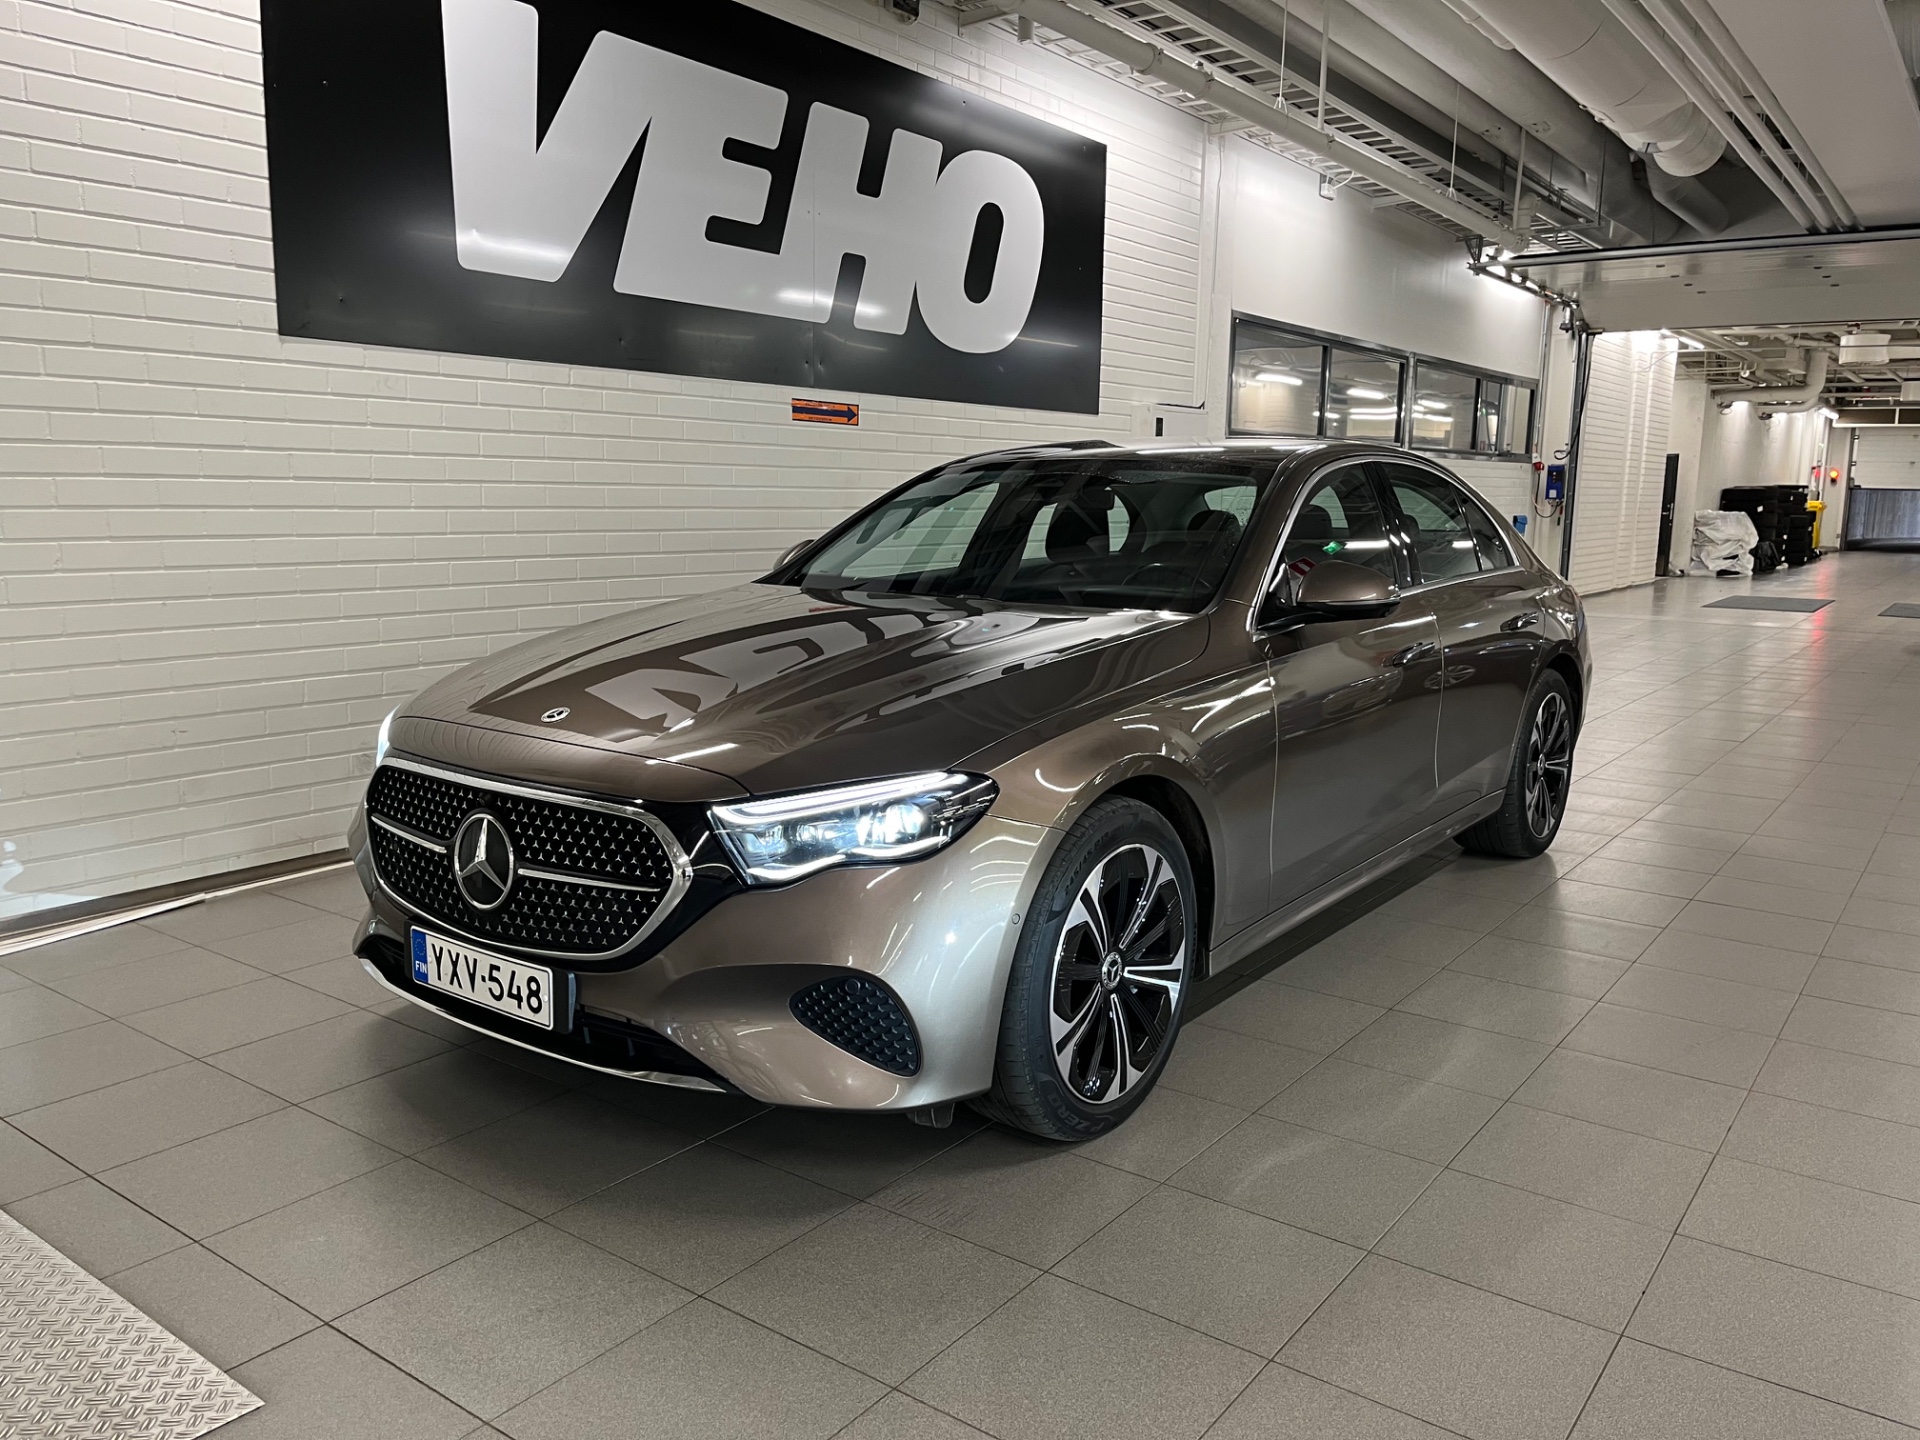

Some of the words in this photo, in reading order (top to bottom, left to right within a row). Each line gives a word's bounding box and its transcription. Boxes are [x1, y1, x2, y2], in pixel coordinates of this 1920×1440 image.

[441, 0, 1045, 354] VEHO
[415, 960, 428, 975] FIN
[431, 943, 543, 1015] YXV-548
[1048, 1095, 1091, 1131] ZERO
